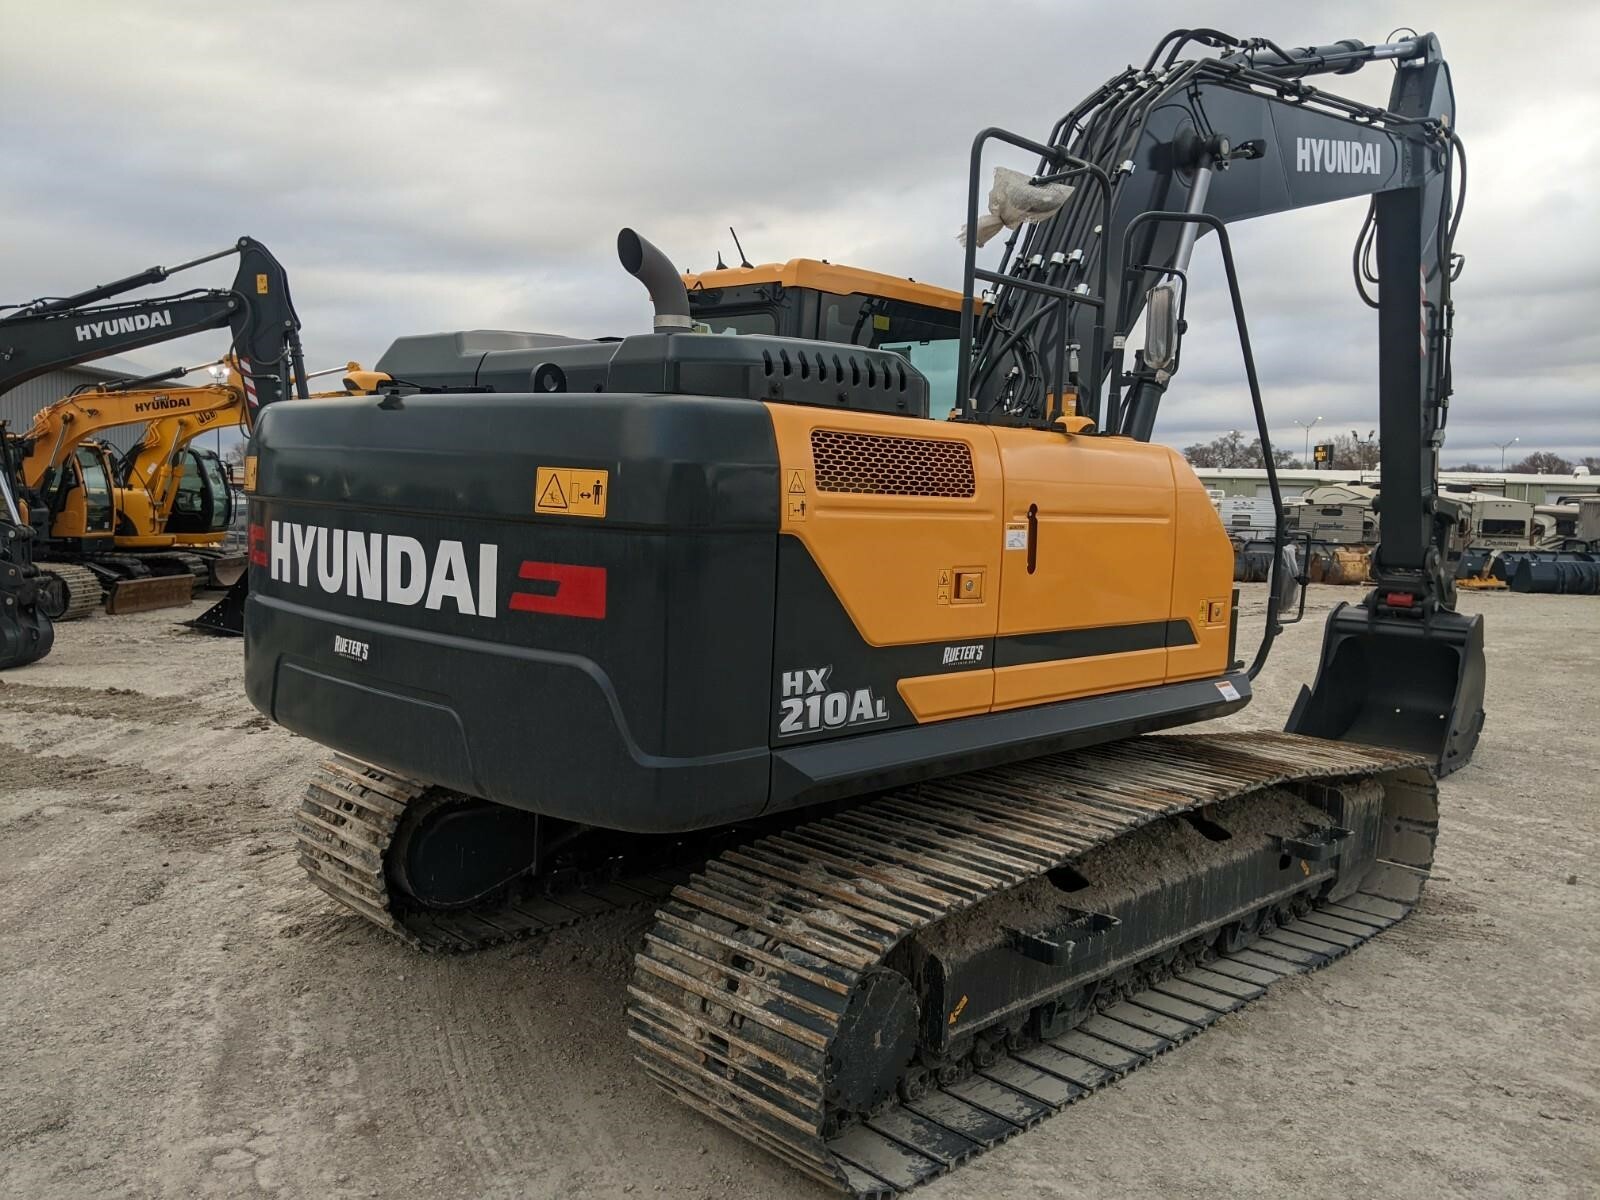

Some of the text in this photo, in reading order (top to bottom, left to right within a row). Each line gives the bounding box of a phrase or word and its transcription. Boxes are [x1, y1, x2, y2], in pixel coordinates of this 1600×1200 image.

[1296, 137, 1381, 175] HYUNDAI
[75, 310, 173, 342] HYUNDAI
[135, 397, 191, 413] HYUNDAI
[197, 409, 216, 424] JCB
[271, 520, 498, 618] HYUNDAI
[334, 635, 369, 660] RUETER'S
[942, 644, 984, 665] RUETER'S
[781, 667, 827, 697] HX
